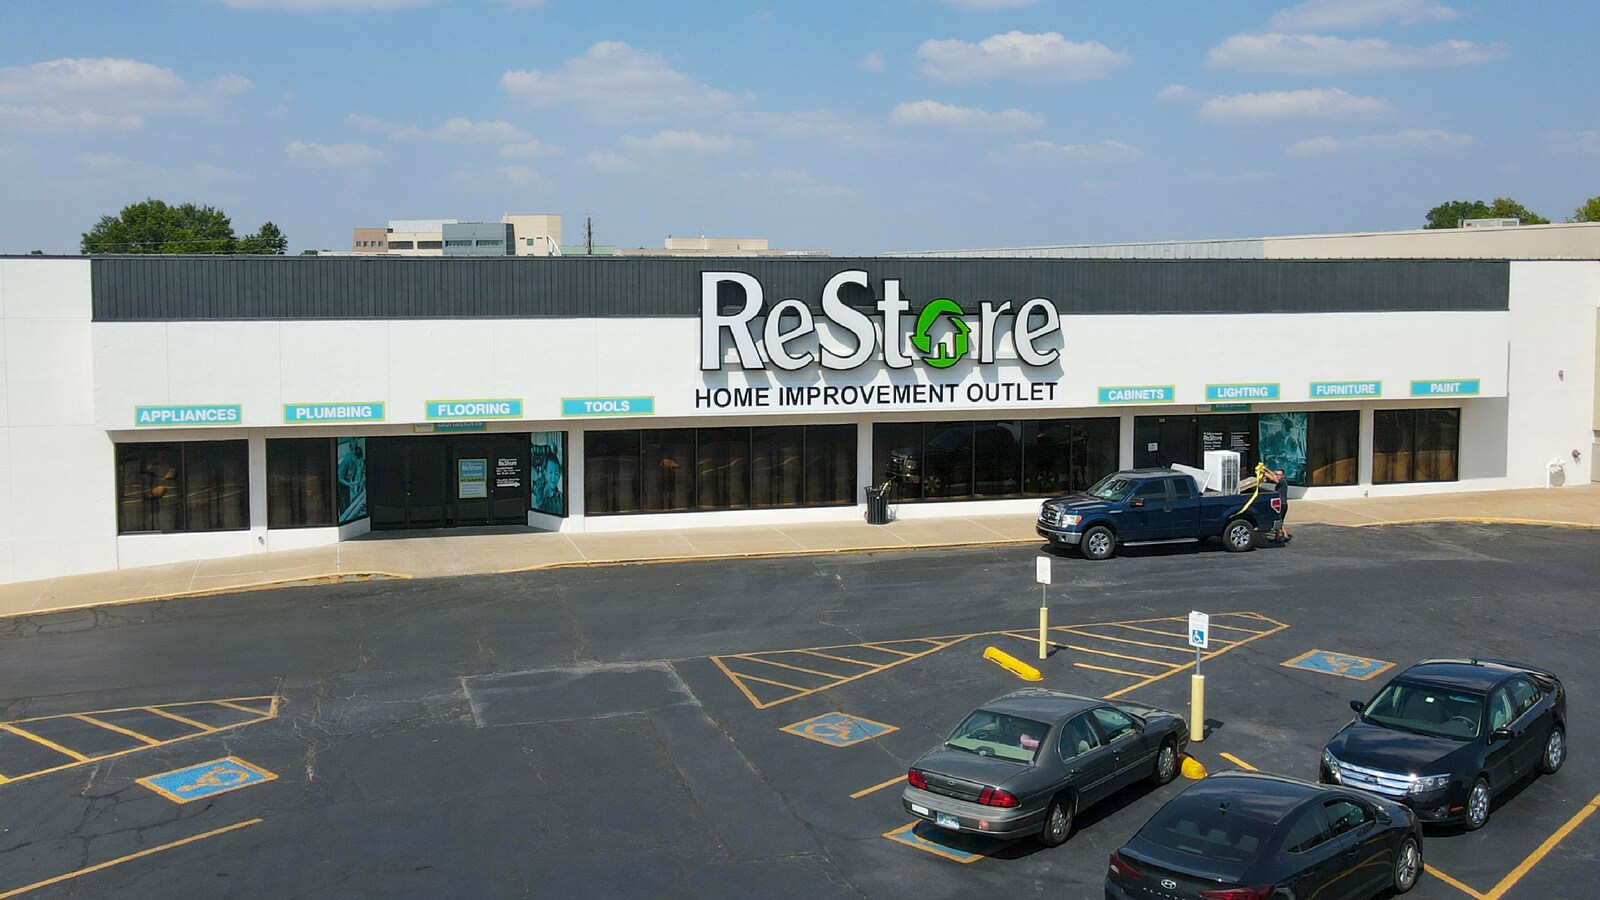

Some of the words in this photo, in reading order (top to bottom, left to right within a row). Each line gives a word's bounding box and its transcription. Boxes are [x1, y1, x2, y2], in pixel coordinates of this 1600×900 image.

[700, 269, 1061, 370] ReStore
[1217, 387, 1268, 399] LIGHTING
[1316, 384, 1375, 395] FURNITURE
[1430, 382, 1460, 393] PAINT
[695, 387, 770, 408] HOME
[779, 384, 959, 406] IMPROVEMENT
[967, 382, 1058, 403] OUTLET
[1108, 389, 1164, 401] CABINETS
[296, 406, 372, 420] PLUMBING
[438, 402, 510, 416] FLOORING
[584, 400, 629, 413] TOOLS
[141, 408, 237, 422] APPLIANCES
